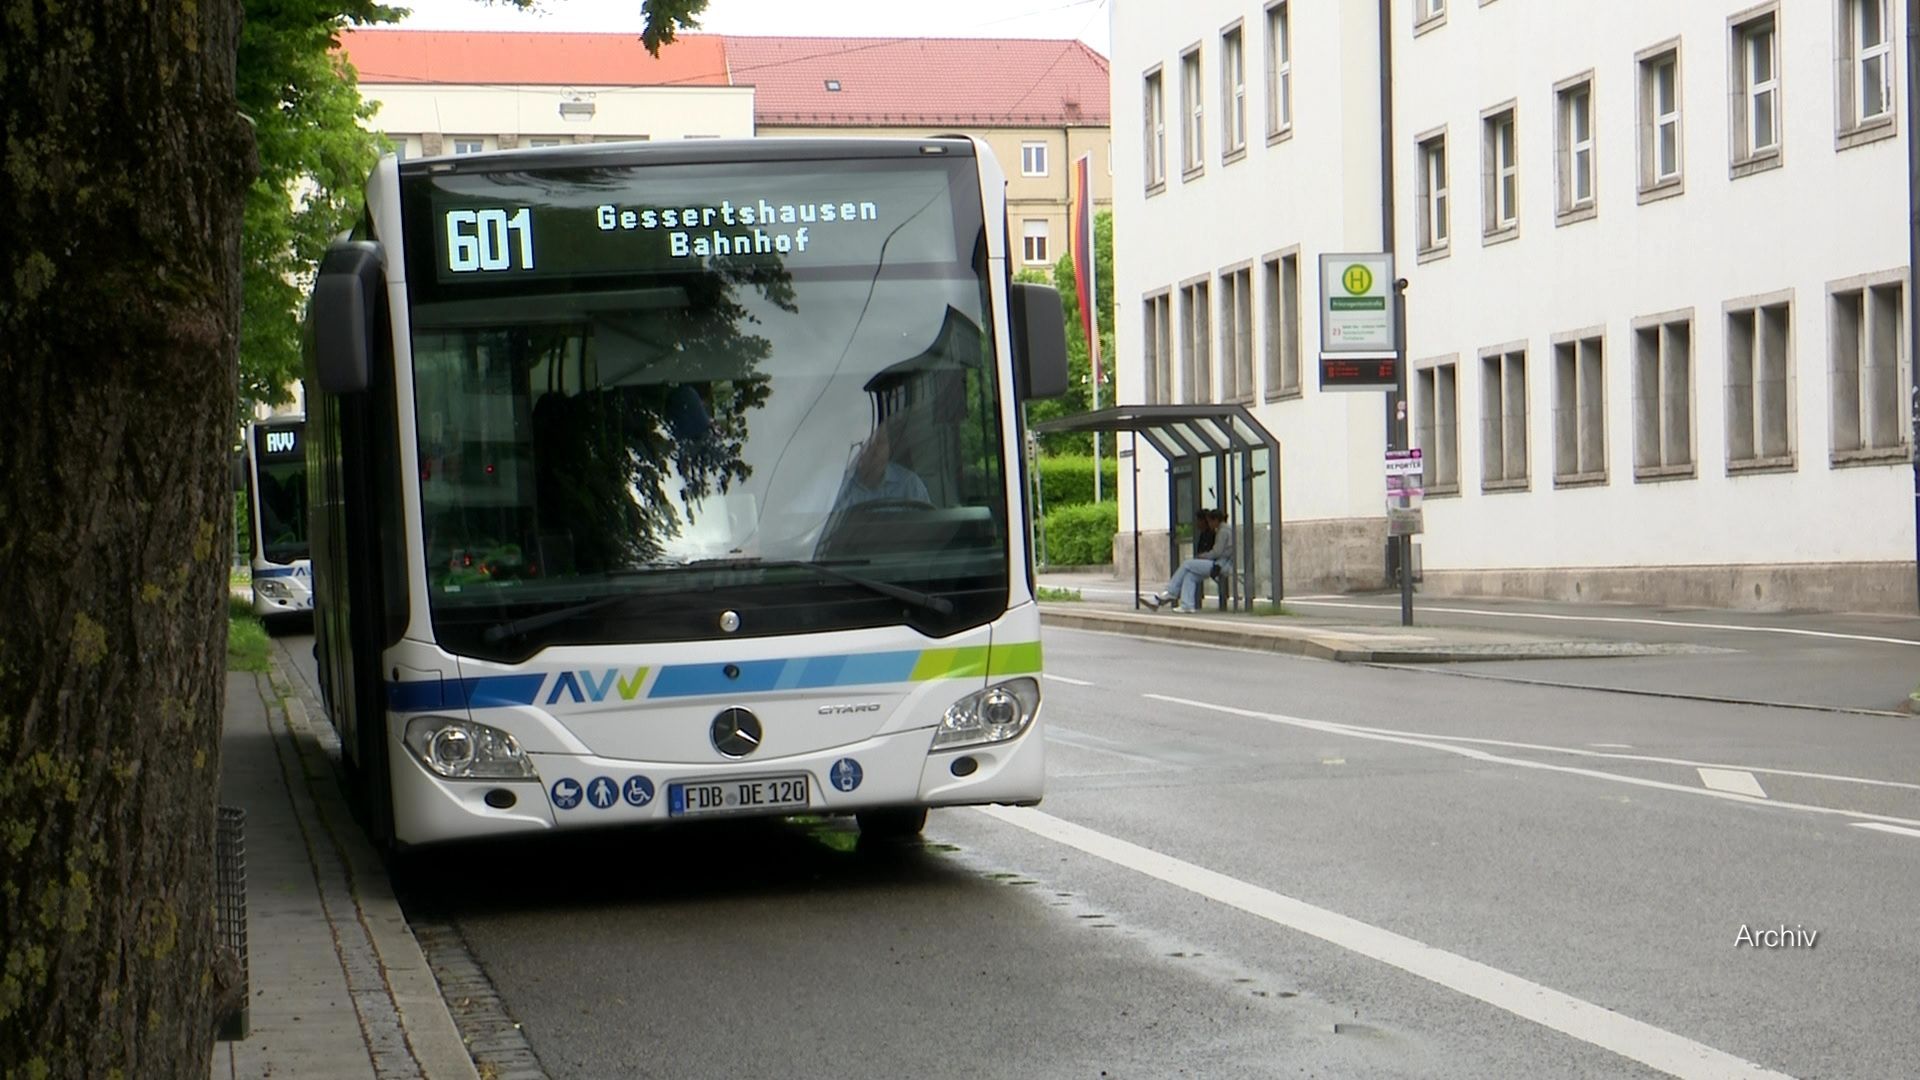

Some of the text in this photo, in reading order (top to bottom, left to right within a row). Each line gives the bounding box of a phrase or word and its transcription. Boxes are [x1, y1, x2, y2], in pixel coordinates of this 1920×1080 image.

[597, 199, 878, 230] Gessertshausen
[446, 207, 534, 272] 601
[669, 227, 810, 257] Bahnhof
[1350, 271, 1364, 289] H
[266, 432, 295, 452] AVV
[1386, 462, 1421, 470] REPORTER
[546, 666, 650, 704] AVV
[818, 703, 881, 715] CITARO
[685, 780, 805, 809] FDB DE 120
